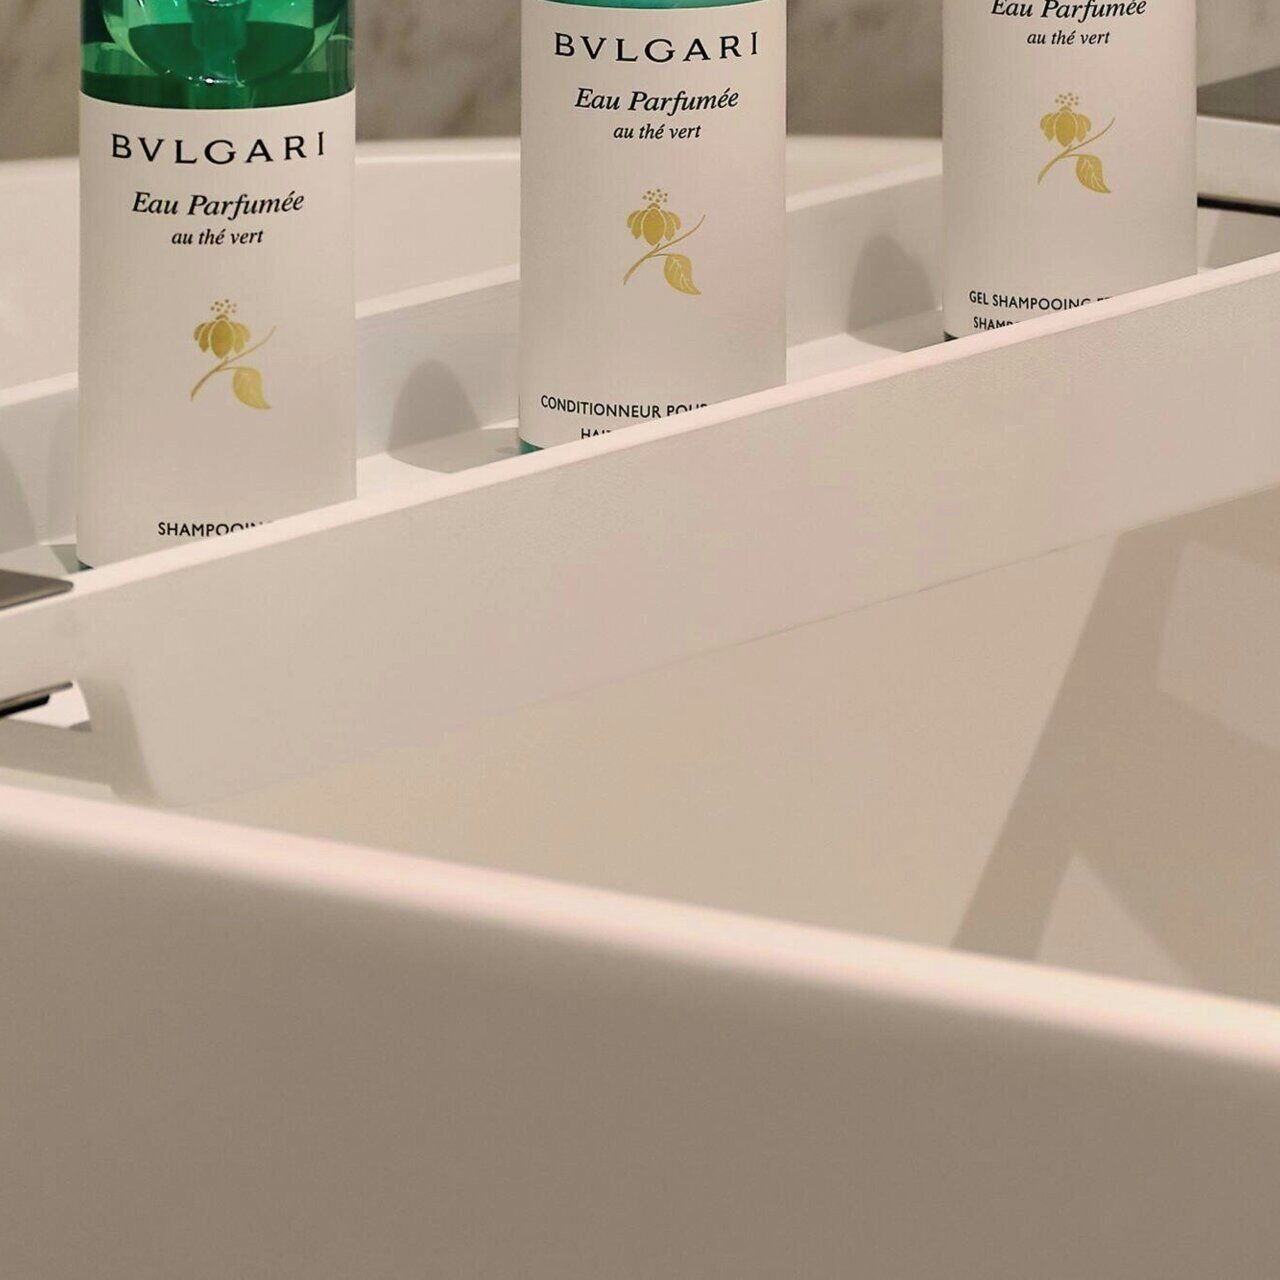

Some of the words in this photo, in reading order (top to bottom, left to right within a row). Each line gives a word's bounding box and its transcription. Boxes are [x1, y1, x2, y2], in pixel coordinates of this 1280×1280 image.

[553, 31, 758, 64] BVLGARI
[1026, 33, 1047, 45] au
[1051, 29, 1077, 46] thé
[1080, 31, 1111, 45] vert
[573, 87, 621, 111] Eau
[627, 87, 739, 117] Parfumée
[612, 126, 635, 139] au
[638, 122, 666, 140] thé
[668, 124, 702, 140] vert
[111, 131, 324, 166] BVLGARI
[131, 190, 179, 216] Eau
[186, 190, 305, 222] Parfumée
[171, 232, 194, 246] au
[197, 228, 227, 246] thé
[230, 229, 264, 245] vert
[968, 289, 990, 306] GEL
[540, 394, 662, 419] CONDITIONNEUR
